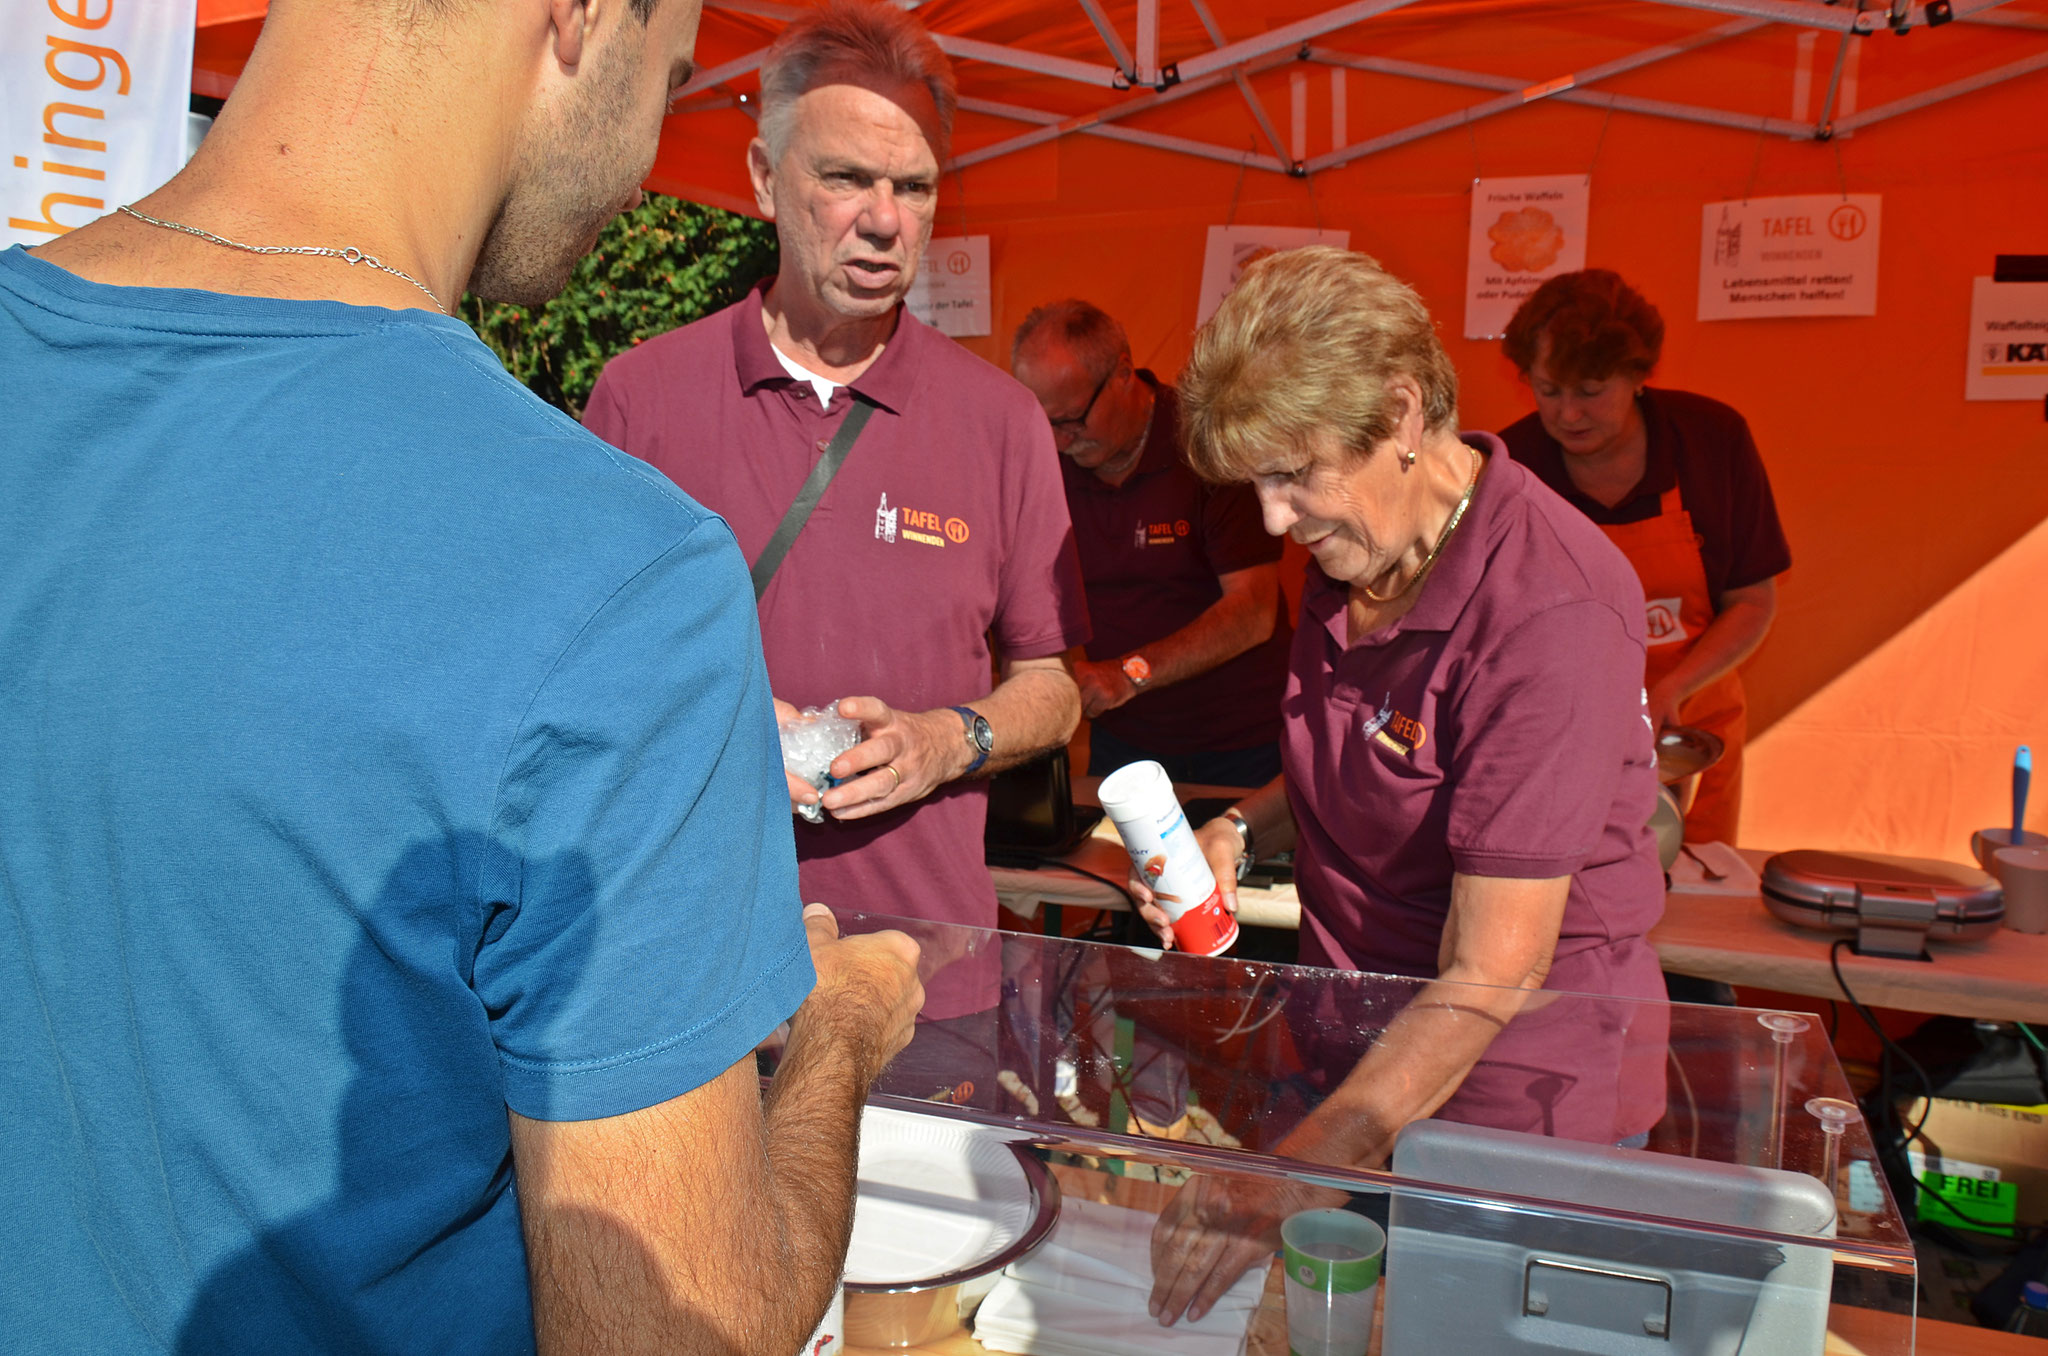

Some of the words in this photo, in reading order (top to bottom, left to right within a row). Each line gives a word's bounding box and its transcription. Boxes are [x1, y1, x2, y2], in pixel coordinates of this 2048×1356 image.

[1525, 191, 1564, 201] Waffeln
[1761, 216, 1814, 237] TAFEL
[1723, 275, 1807, 289] Lebensmittel
[1810, 273, 1853, 285] retten!
[1729, 291, 1796, 303] Menschen
[1800, 289, 1845, 301] helfen!
[901, 506, 943, 533] TAFEL
[901, 528, 946, 548] WINNENDEN
[1938, 1173, 2000, 1199] FREI
